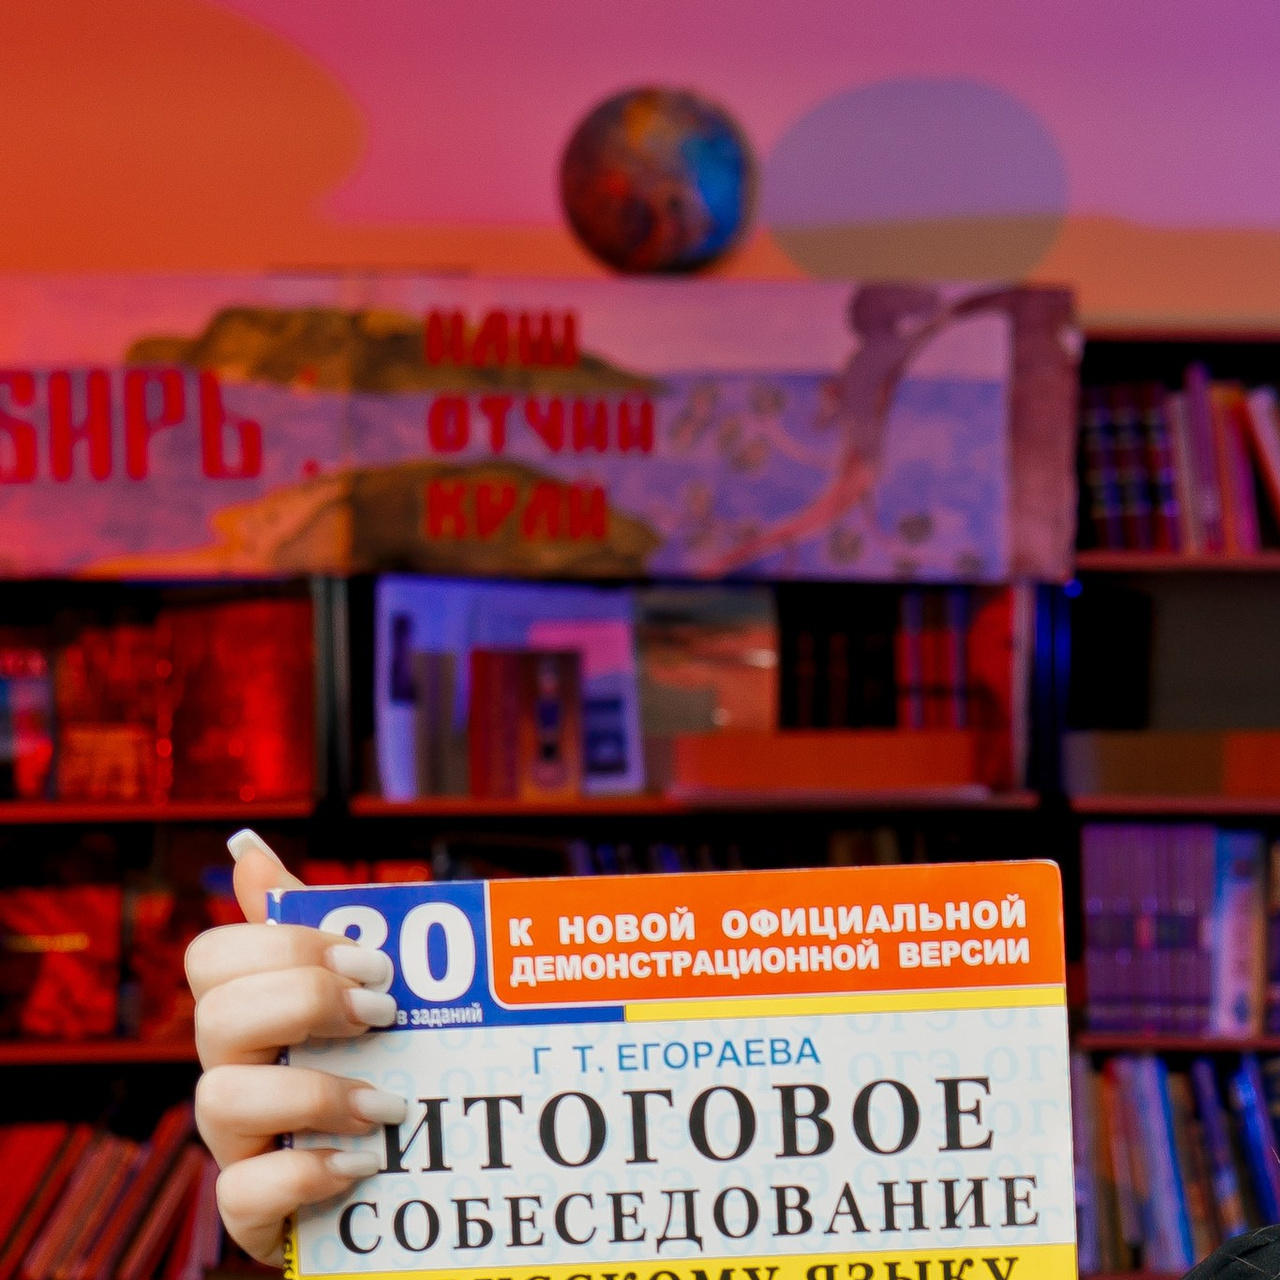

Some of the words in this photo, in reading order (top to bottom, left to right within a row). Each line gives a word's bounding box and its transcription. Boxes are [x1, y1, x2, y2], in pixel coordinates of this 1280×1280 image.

[509, 917, 533, 946] К
[558, 905, 696, 945] НОВОЙ
[722, 893, 1028, 941] ОФИЦИАЛЬНОЙ
[509, 937, 880, 987] ДЕМОНСТРАЦИОННОЙ
[898, 937, 1030, 968] ВЕРСИИ
[410, 1002, 483, 1027] заданий
[617, 1036, 822, 1072] ЕГОРАЕВА
[377, 1076, 993, 1175] ИТОГОВОЕ
[337, 1175, 1039, 1254] СОБЕСЕДОВАНИЕ
